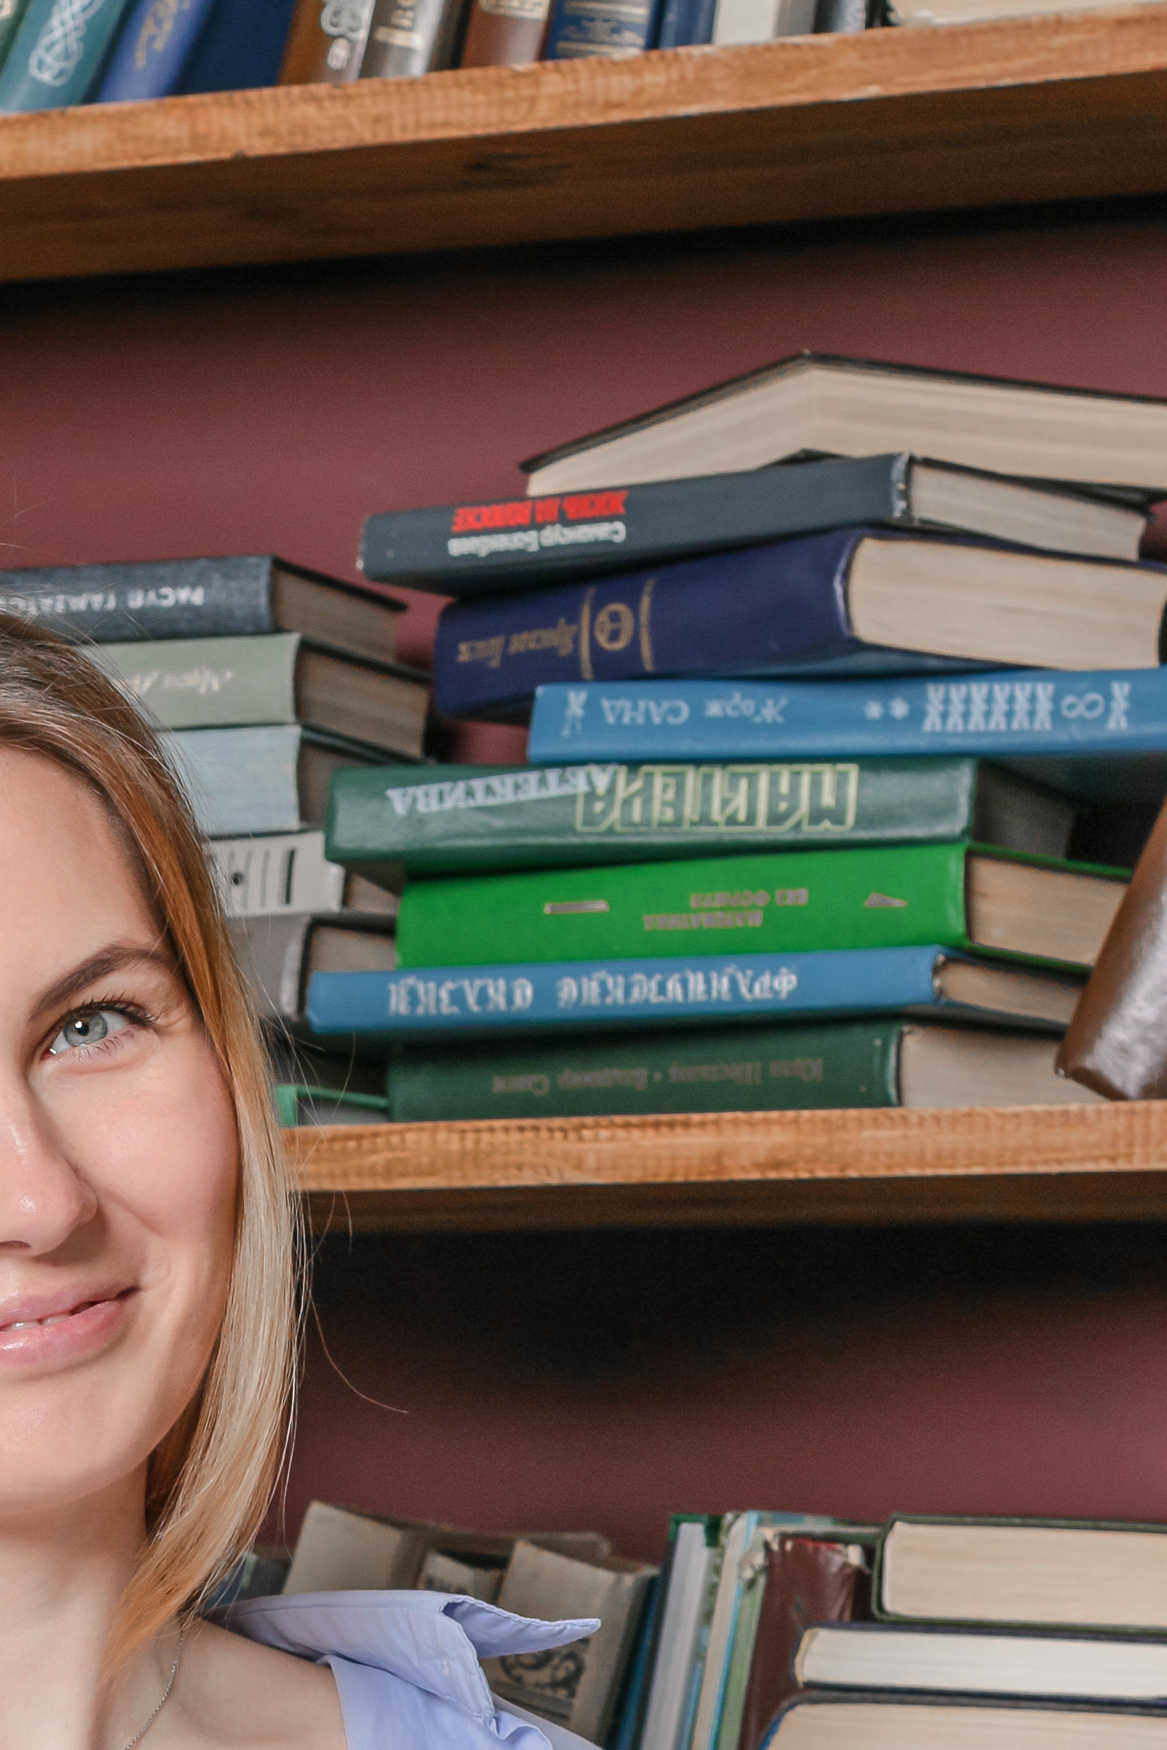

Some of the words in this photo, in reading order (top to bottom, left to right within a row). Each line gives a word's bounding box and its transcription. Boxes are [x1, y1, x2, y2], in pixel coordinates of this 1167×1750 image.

[126, 585, 205, 610] РАСУЛ
[599, 696, 691, 725] САНД
[705, 692, 789, 726] Жорж
[385, 763, 618, 817] ДЕТЕКТИВА
[576, 763, 859, 834] МАСТЕРА
[689, 889, 772, 909] ФОРМУЛ
[774, 887, 810, 906] БЕЗ
[642, 909, 764, 932] МАТЕМАТИКА
[386, 972, 535, 1017] СКАЗКИ
[554, 963, 800, 1007] ФРАНЦУЗСКИЕ
